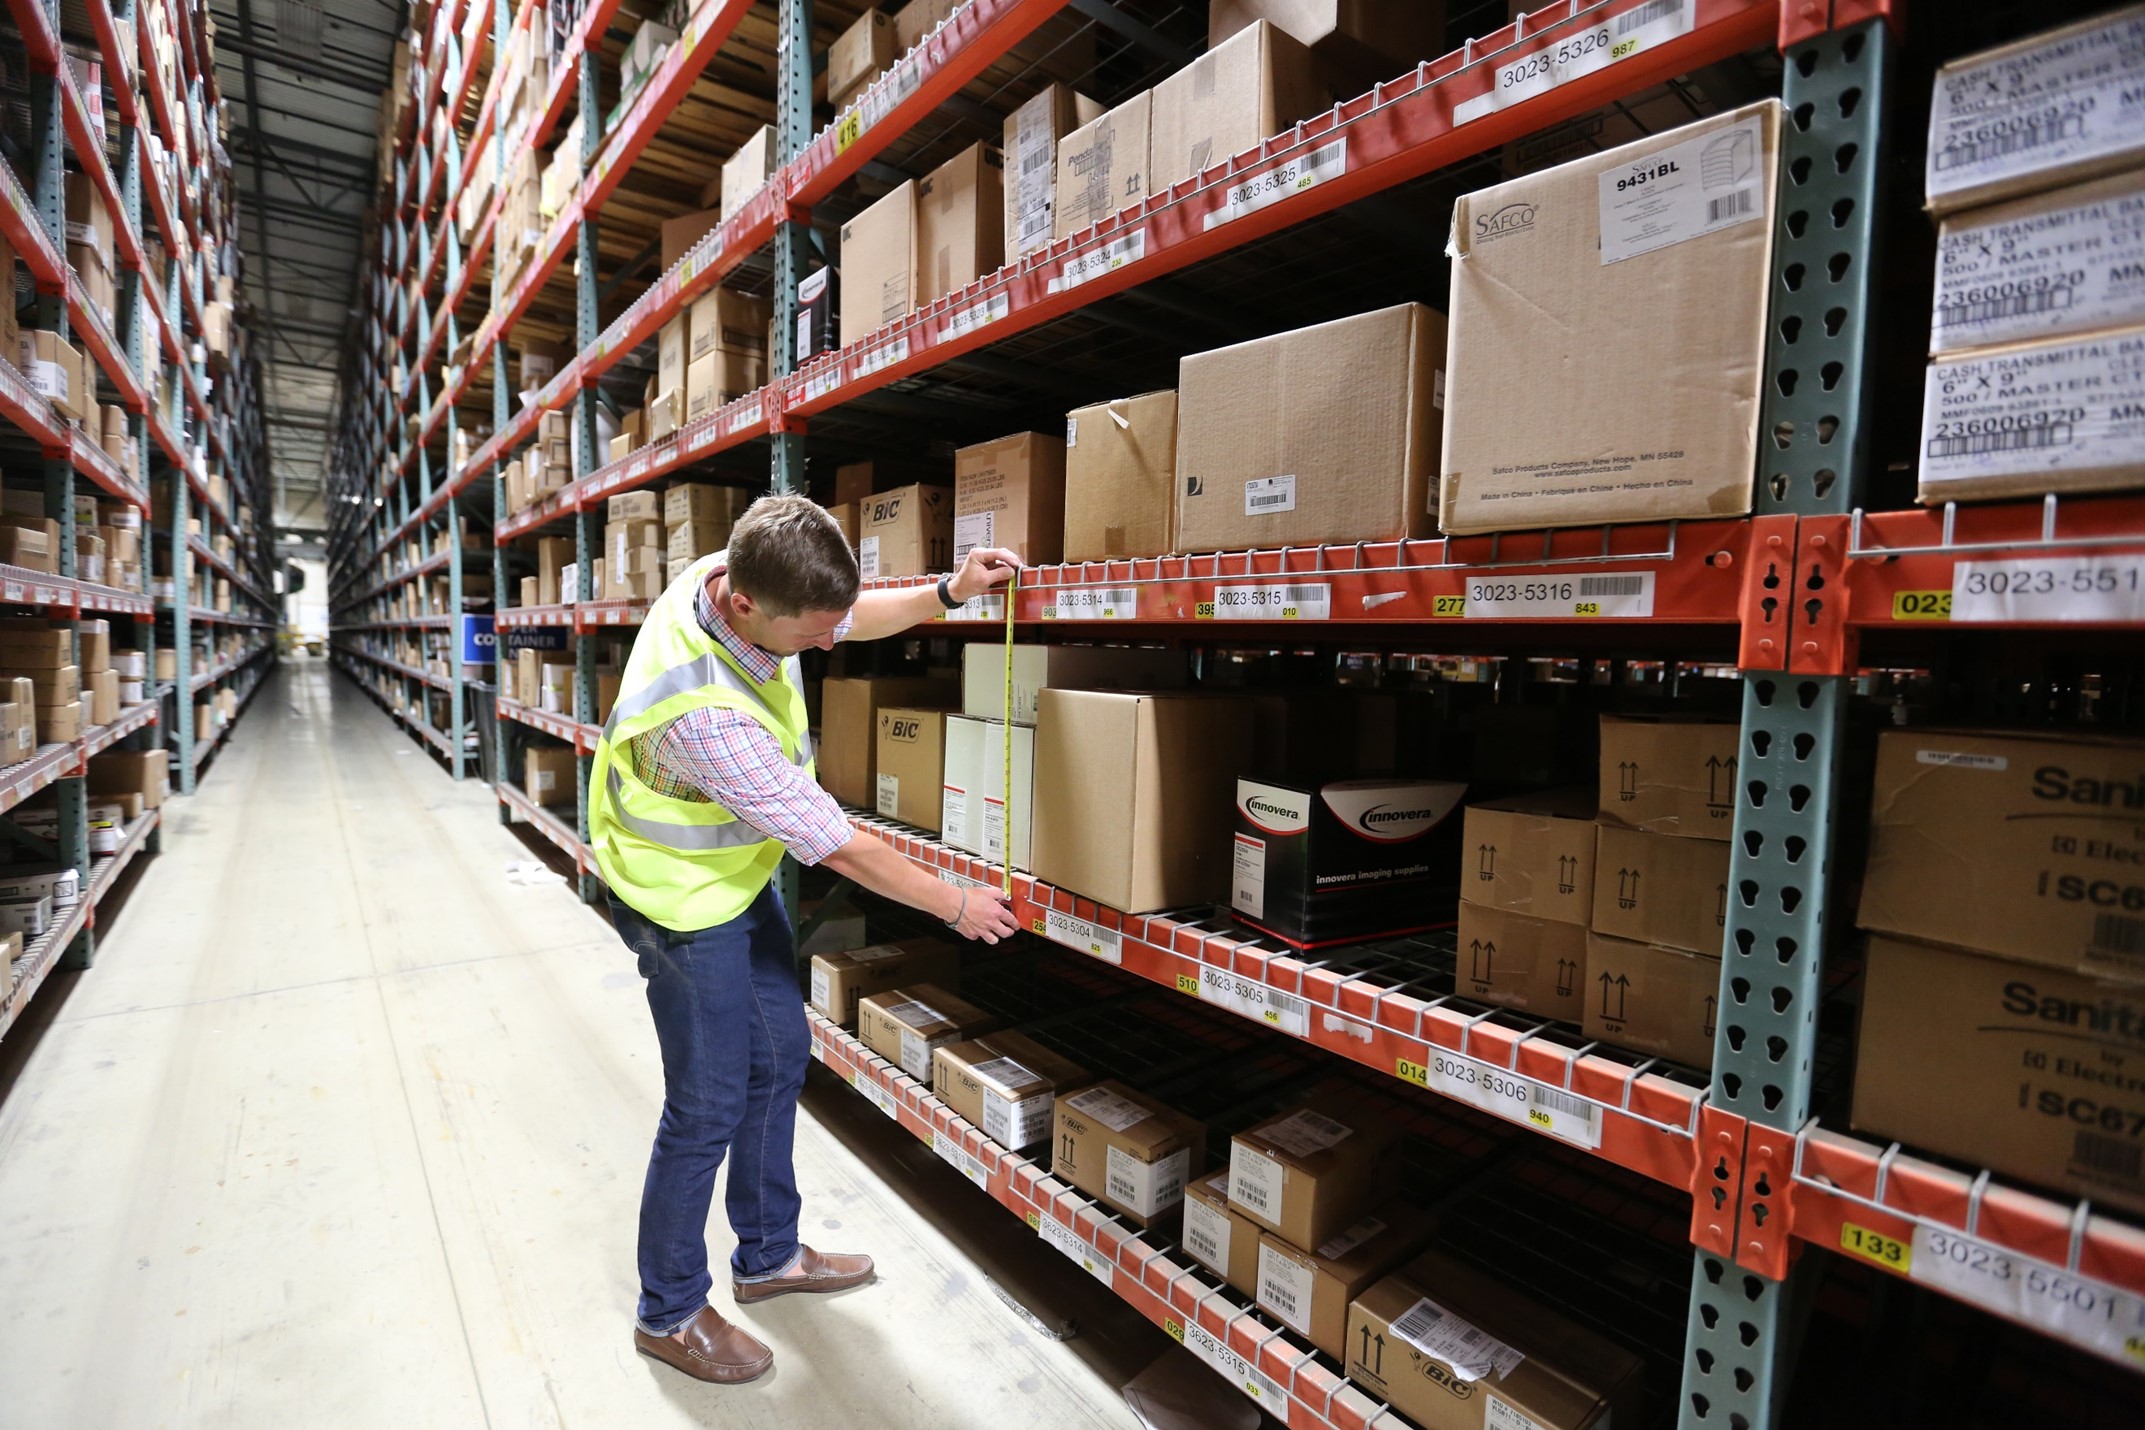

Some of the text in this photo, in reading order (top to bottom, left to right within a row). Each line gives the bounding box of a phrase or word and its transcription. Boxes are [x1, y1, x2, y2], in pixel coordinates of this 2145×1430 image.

[1502, 28, 1610, 89] 3023-5326
[1611, 40, 1636, 59] 987
[839, 117, 859, 147] 416
[1231, 166, 1296, 205] 3023-5325
[1297, 176, 1312, 188] 485
[1617, 161, 1680, 191] 9431BL
[1476, 206, 1535, 236] SAFCO
[1938, 232, 1984, 251] CASH
[1989, 205, 2109, 240] TRANSMITTAL
[1067, 249, 1111, 279] 3023-5324
[1943, 262, 1979, 276] 500
[2000, 237, 2101, 265] MASTER
[1938, 269, 2086, 310] 236006920
[1937, 363, 1983, 380] CASH
[1988, 346, 2109, 371] TRANSMITTAL
[1942, 392, 1978, 406] 500
[1999, 377, 2101, 399] MASTER
[1935, 407, 2086, 439] 236006920
[1492, 466, 1514, 475] Safco
[1515, 463, 1549, 473] Products
[1551, 459, 1590, 471] Company,
[1592, 458, 1610, 466] New
[1613, 455, 1637, 465] Hope,
[1640, 453, 1655, 461] MN
[1481, 493, 1501, 501] Made
[1511, 490, 1533, 499] China
[1541, 487, 1575, 496] Fabrique
[1589, 484, 1614, 493] Chine
[1623, 481, 1651, 490] Hecho
[1667, 478, 1693, 487] China
[1059, 595, 1103, 606] 3023-5314
[1219, 591, 1281, 607] 3023-5315
[1472, 583, 1573, 602] 3023-5316
[1282, 608, 1296, 616] 010
[1437, 599, 1465, 612] 277
[1575, 603, 1597, 614] 843
[1250, 797, 1300, 820] innovera
[1621, 794, 1636, 802] UP
[1368, 808, 1432, 824] innovera
[1711, 810, 1729, 818] UP
[1316, 864, 1430, 884] innovera imaging supplies
[1559, 886, 1575, 895] UP
[1619, 900, 1637, 909] UP
[1048, 914, 1090, 938] 3023-5304
[1179, 977, 1197, 992] 510
[1204, 971, 1264, 1003] 3023-5305
[1475, 986, 1489, 994] UP
[1557, 989, 1572, 997] UP
[1264, 1010, 1278, 1020] 456
[1606, 1024, 1622, 1033] UP
[1400, 1061, 1427, 1084] 014
[1435, 1057, 1527, 1102] 3023-5306
[1529, 1109, 1550, 1124] 940
[1042, 1217, 1083, 1254] 3623-5314
[1851, 1229, 1902, 1262] 133
[1167, 1319, 1185, 1341] 029
[1189, 1326, 1246, 1375] 3623-5315
[1246, 1381, 1259, 1396] 033
